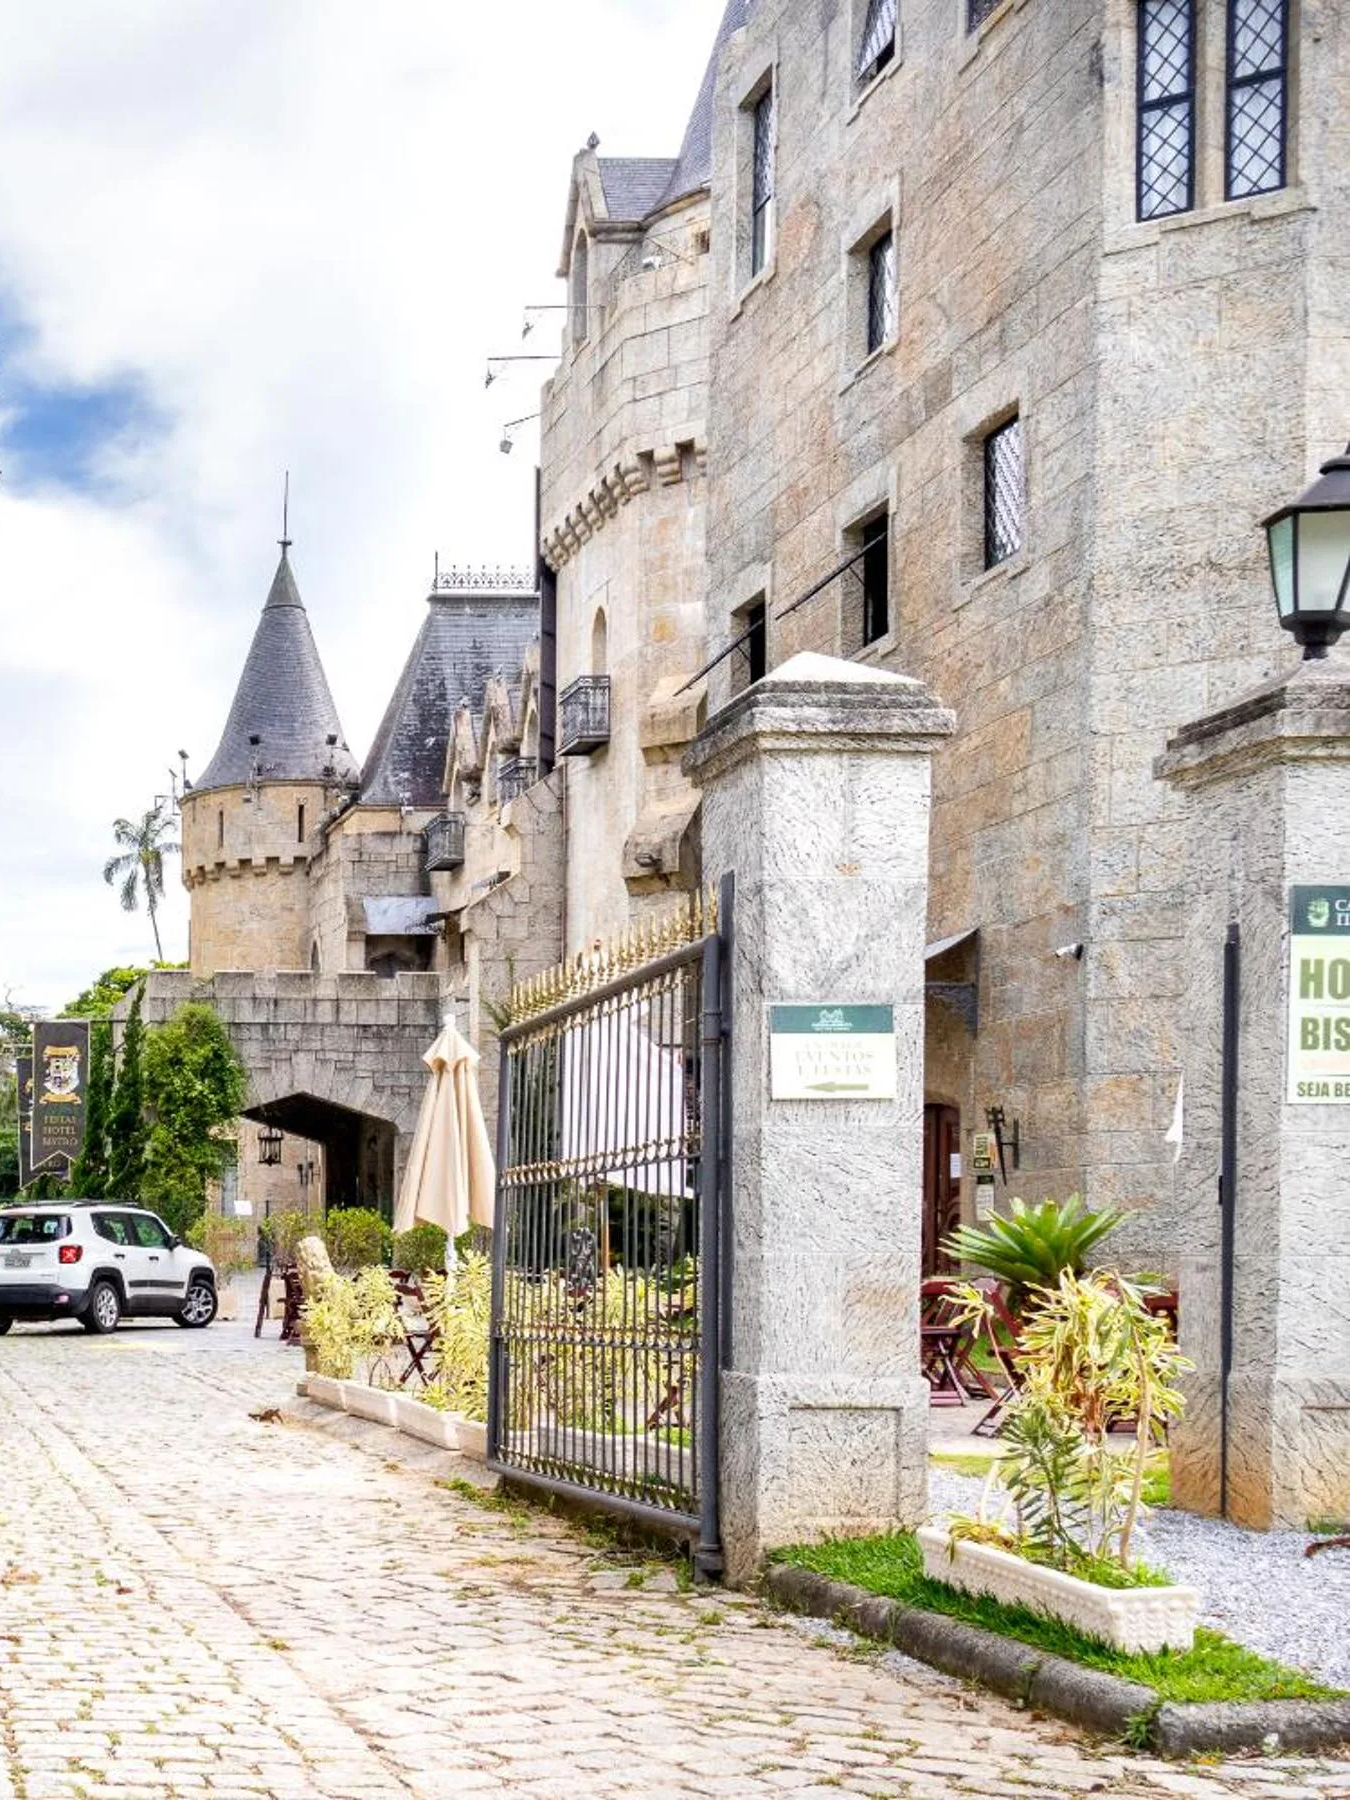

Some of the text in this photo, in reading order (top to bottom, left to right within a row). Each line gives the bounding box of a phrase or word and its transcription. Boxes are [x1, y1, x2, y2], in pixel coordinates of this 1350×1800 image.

[1300, 958, 1350, 1000] HO
[1300, 1016, 1350, 1051] BIS
[1297, 1081, 1329, 1097] SEJA
[42, 1126, 76, 1135] HOTEL
